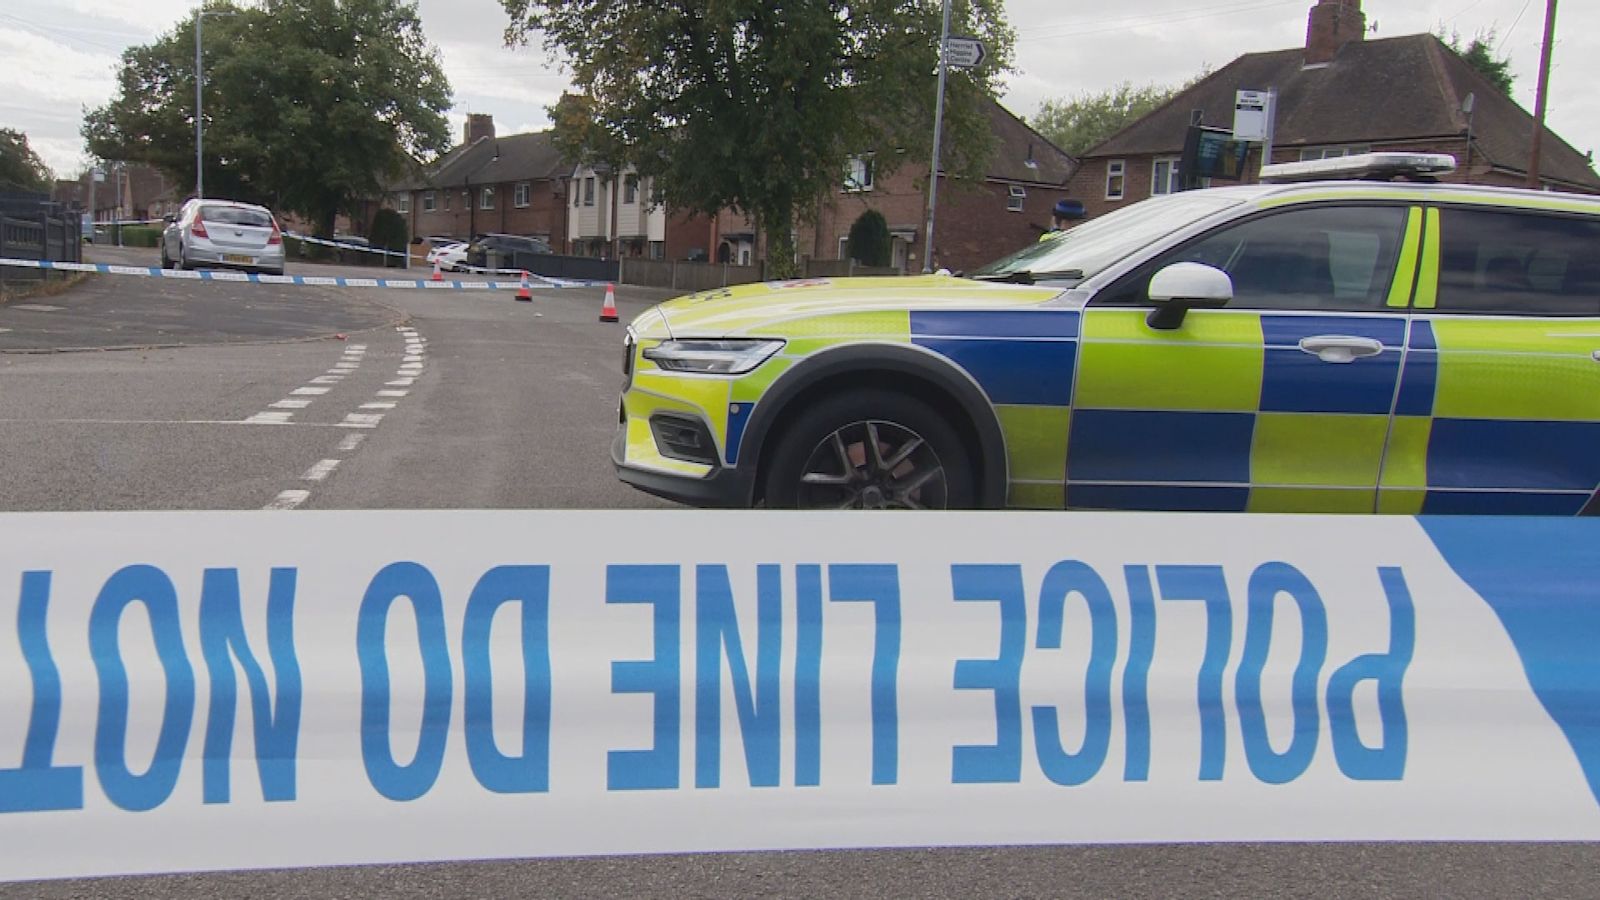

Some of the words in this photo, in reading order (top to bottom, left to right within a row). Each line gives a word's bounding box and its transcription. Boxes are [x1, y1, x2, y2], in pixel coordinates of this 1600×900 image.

[0, 564, 303, 813] NOT
[356, 561, 552, 801] DO
[605, 563, 902, 791] LINE
[951, 559, 1416, 786] POLICE
